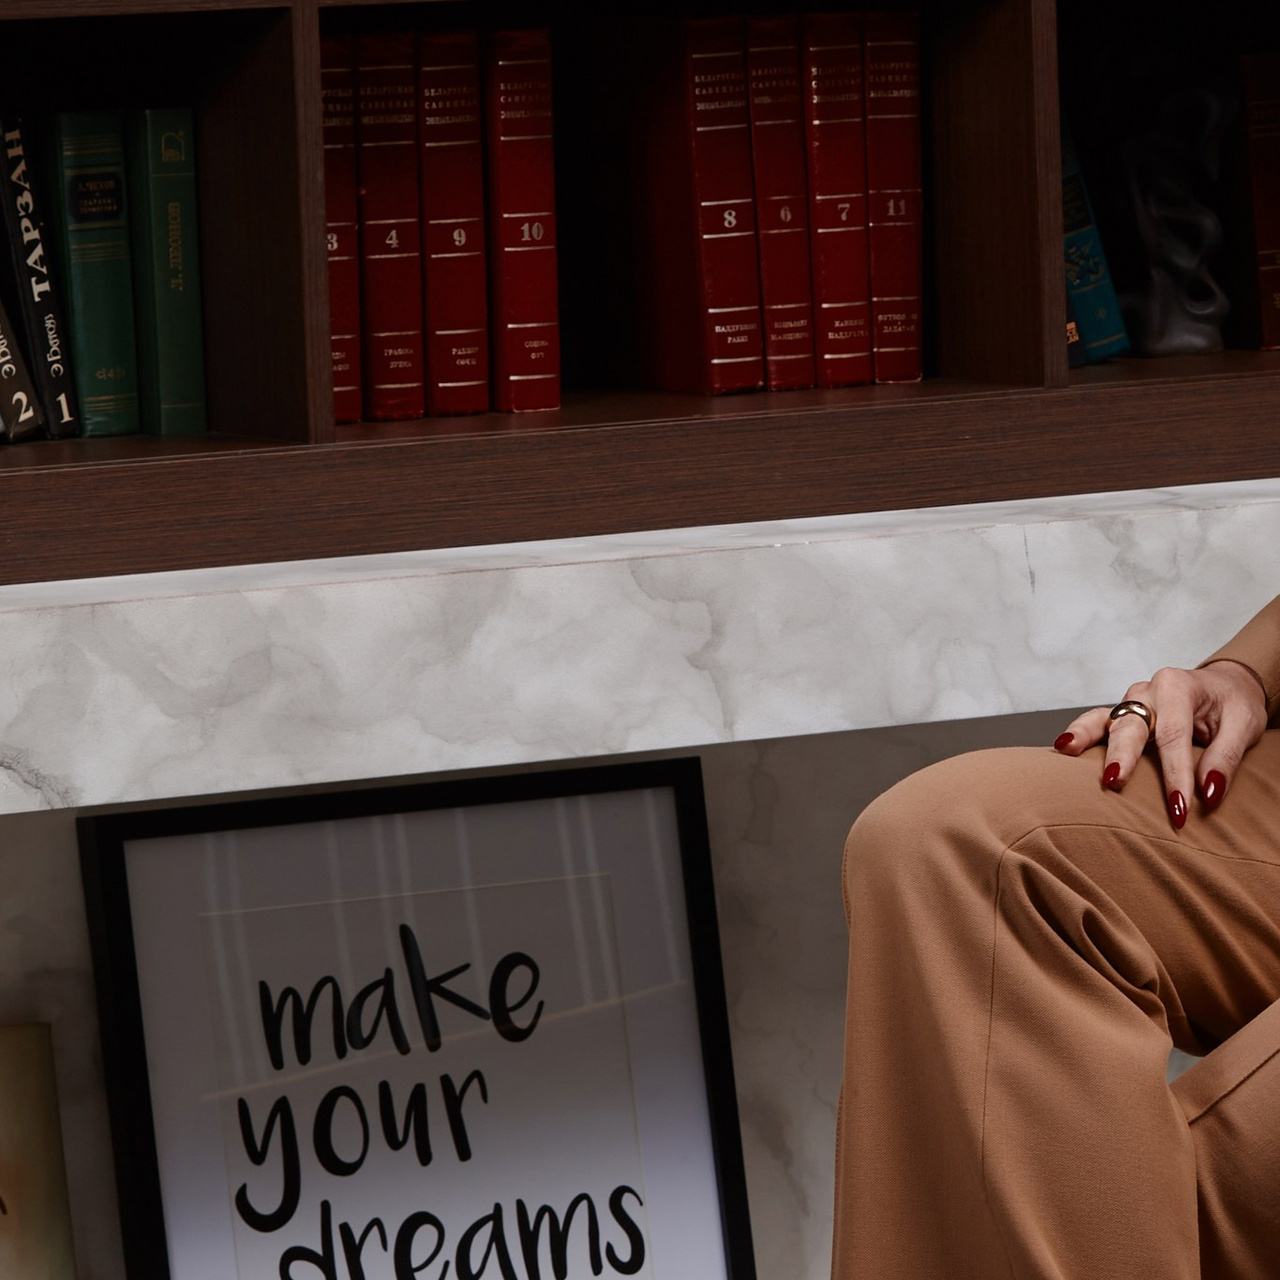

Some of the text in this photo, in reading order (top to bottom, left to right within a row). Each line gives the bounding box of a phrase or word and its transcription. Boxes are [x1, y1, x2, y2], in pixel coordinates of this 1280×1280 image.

[4, 128, 52, 303] ТАРЗАН
[780, 205, 792, 222] 6
[837, 203, 851, 221] 7
[885, 198, 906, 216] 11
[723, 209, 737, 228] 8
[385, 229, 399, 248] 4
[452, 228, 467, 247] 9
[520, 222, 544, 242] 10
[326, 233, 339, 251] 3
[12, 391, 35, 423] 2
[56, 392, 74, 424] 1
[259, 923, 545, 1070] make
[235, 1069, 489, 1232] your
